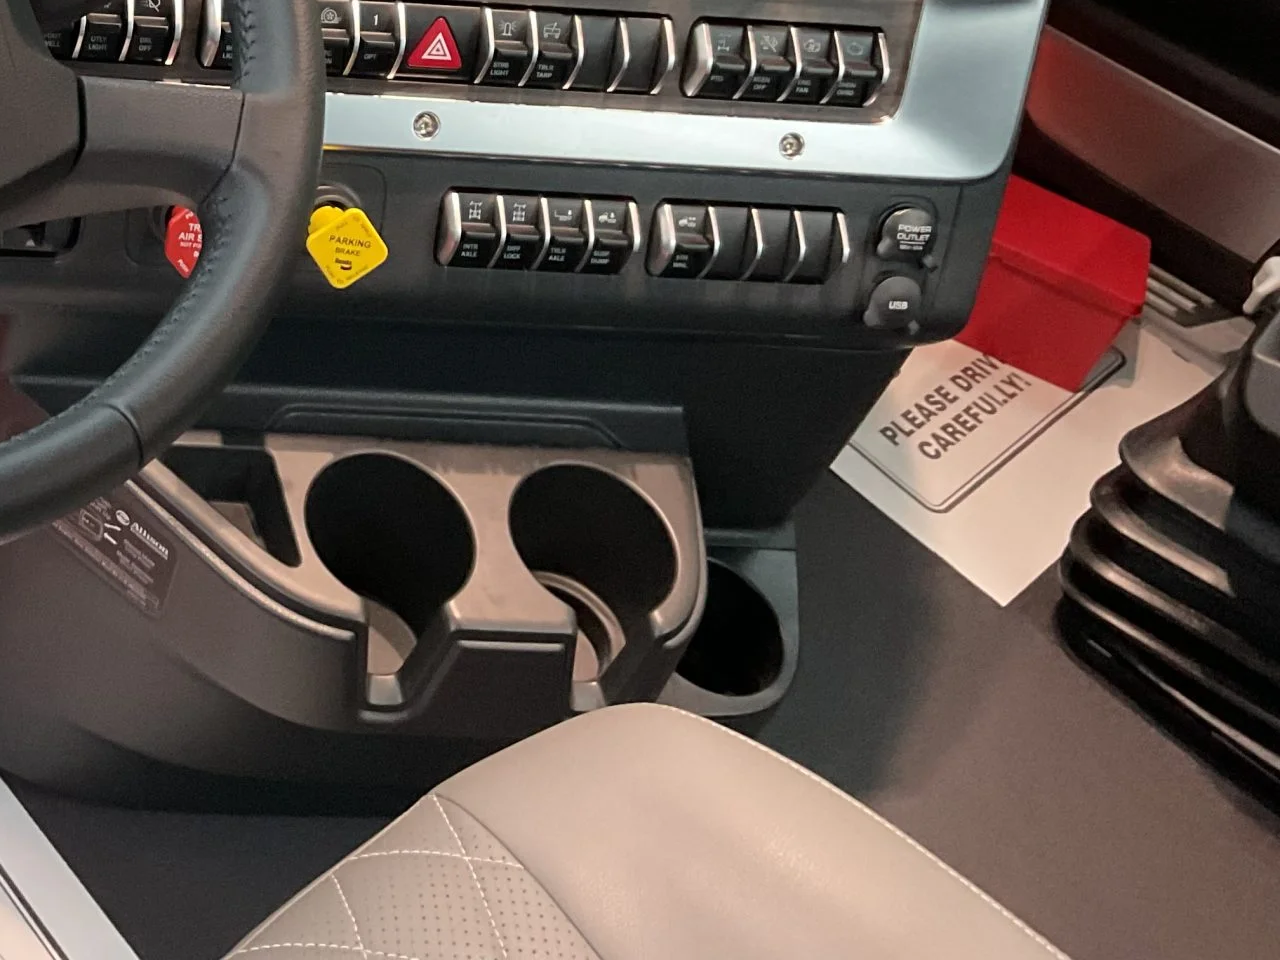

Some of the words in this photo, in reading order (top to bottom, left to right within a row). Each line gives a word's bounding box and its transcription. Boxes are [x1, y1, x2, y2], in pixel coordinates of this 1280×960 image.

[898, 223, 932, 233] POWER
[178, 232, 195, 241] AIR
[329, 235, 371, 248] PARKING
[896, 232, 930, 241] OUTLET
[335, 247, 360, 256] BRAKE
[888, 300, 909, 310] USB
[879, 384, 960, 447] PLEASE
[952, 352, 1006, 393] DRIV
[917, 371, 1034, 461] CAREFULLY!
